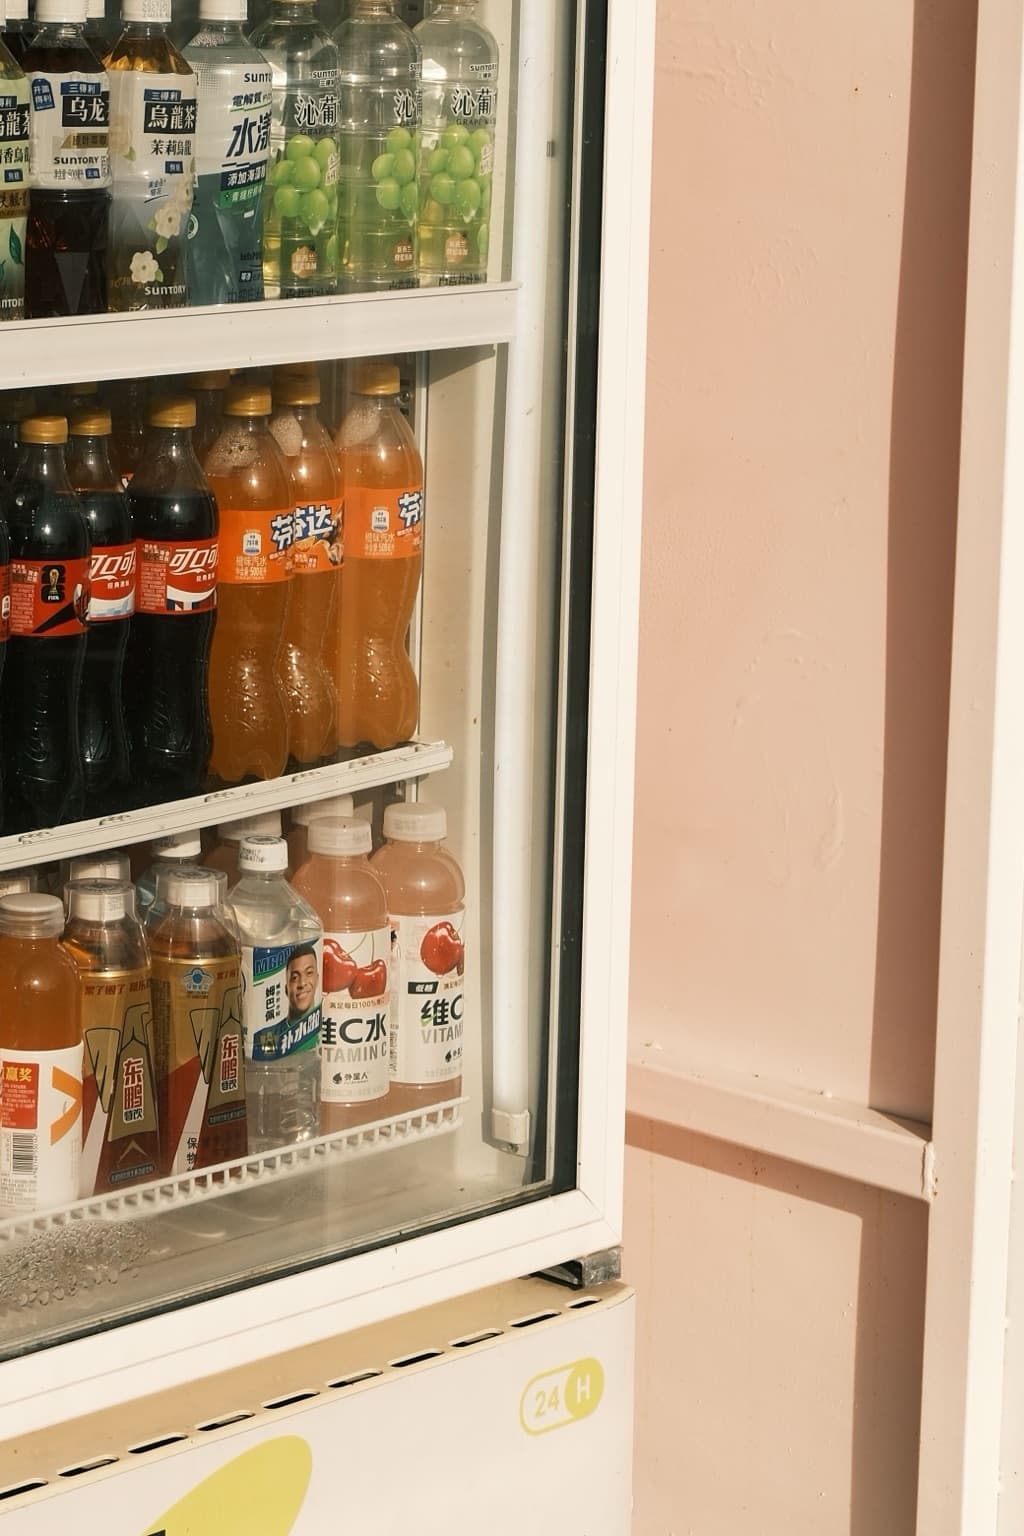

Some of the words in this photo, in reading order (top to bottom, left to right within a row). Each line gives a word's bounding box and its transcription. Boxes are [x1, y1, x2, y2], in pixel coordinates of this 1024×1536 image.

[69, 82, 96, 94] 三得利
[151, 91, 180, 102] 三得利
[66, 97, 109, 123] 乌龙
[451, 87, 497, 116] 沁葡
[148, 104, 195, 130] 烏龍茶
[151, 138, 192, 156] 茉莉烏龍
[53, 155, 99, 165] SUNTORY
[221, 1036, 238, 1081] 东鹏
[2, 1066, 33, 1083] 赢奖
[124, 1058, 144, 1109] 东鹏
[124, 1108, 144, 1122] 特饮
[534, 1386, 561, 1417] 24
[576, 1376, 591, 1403] H
